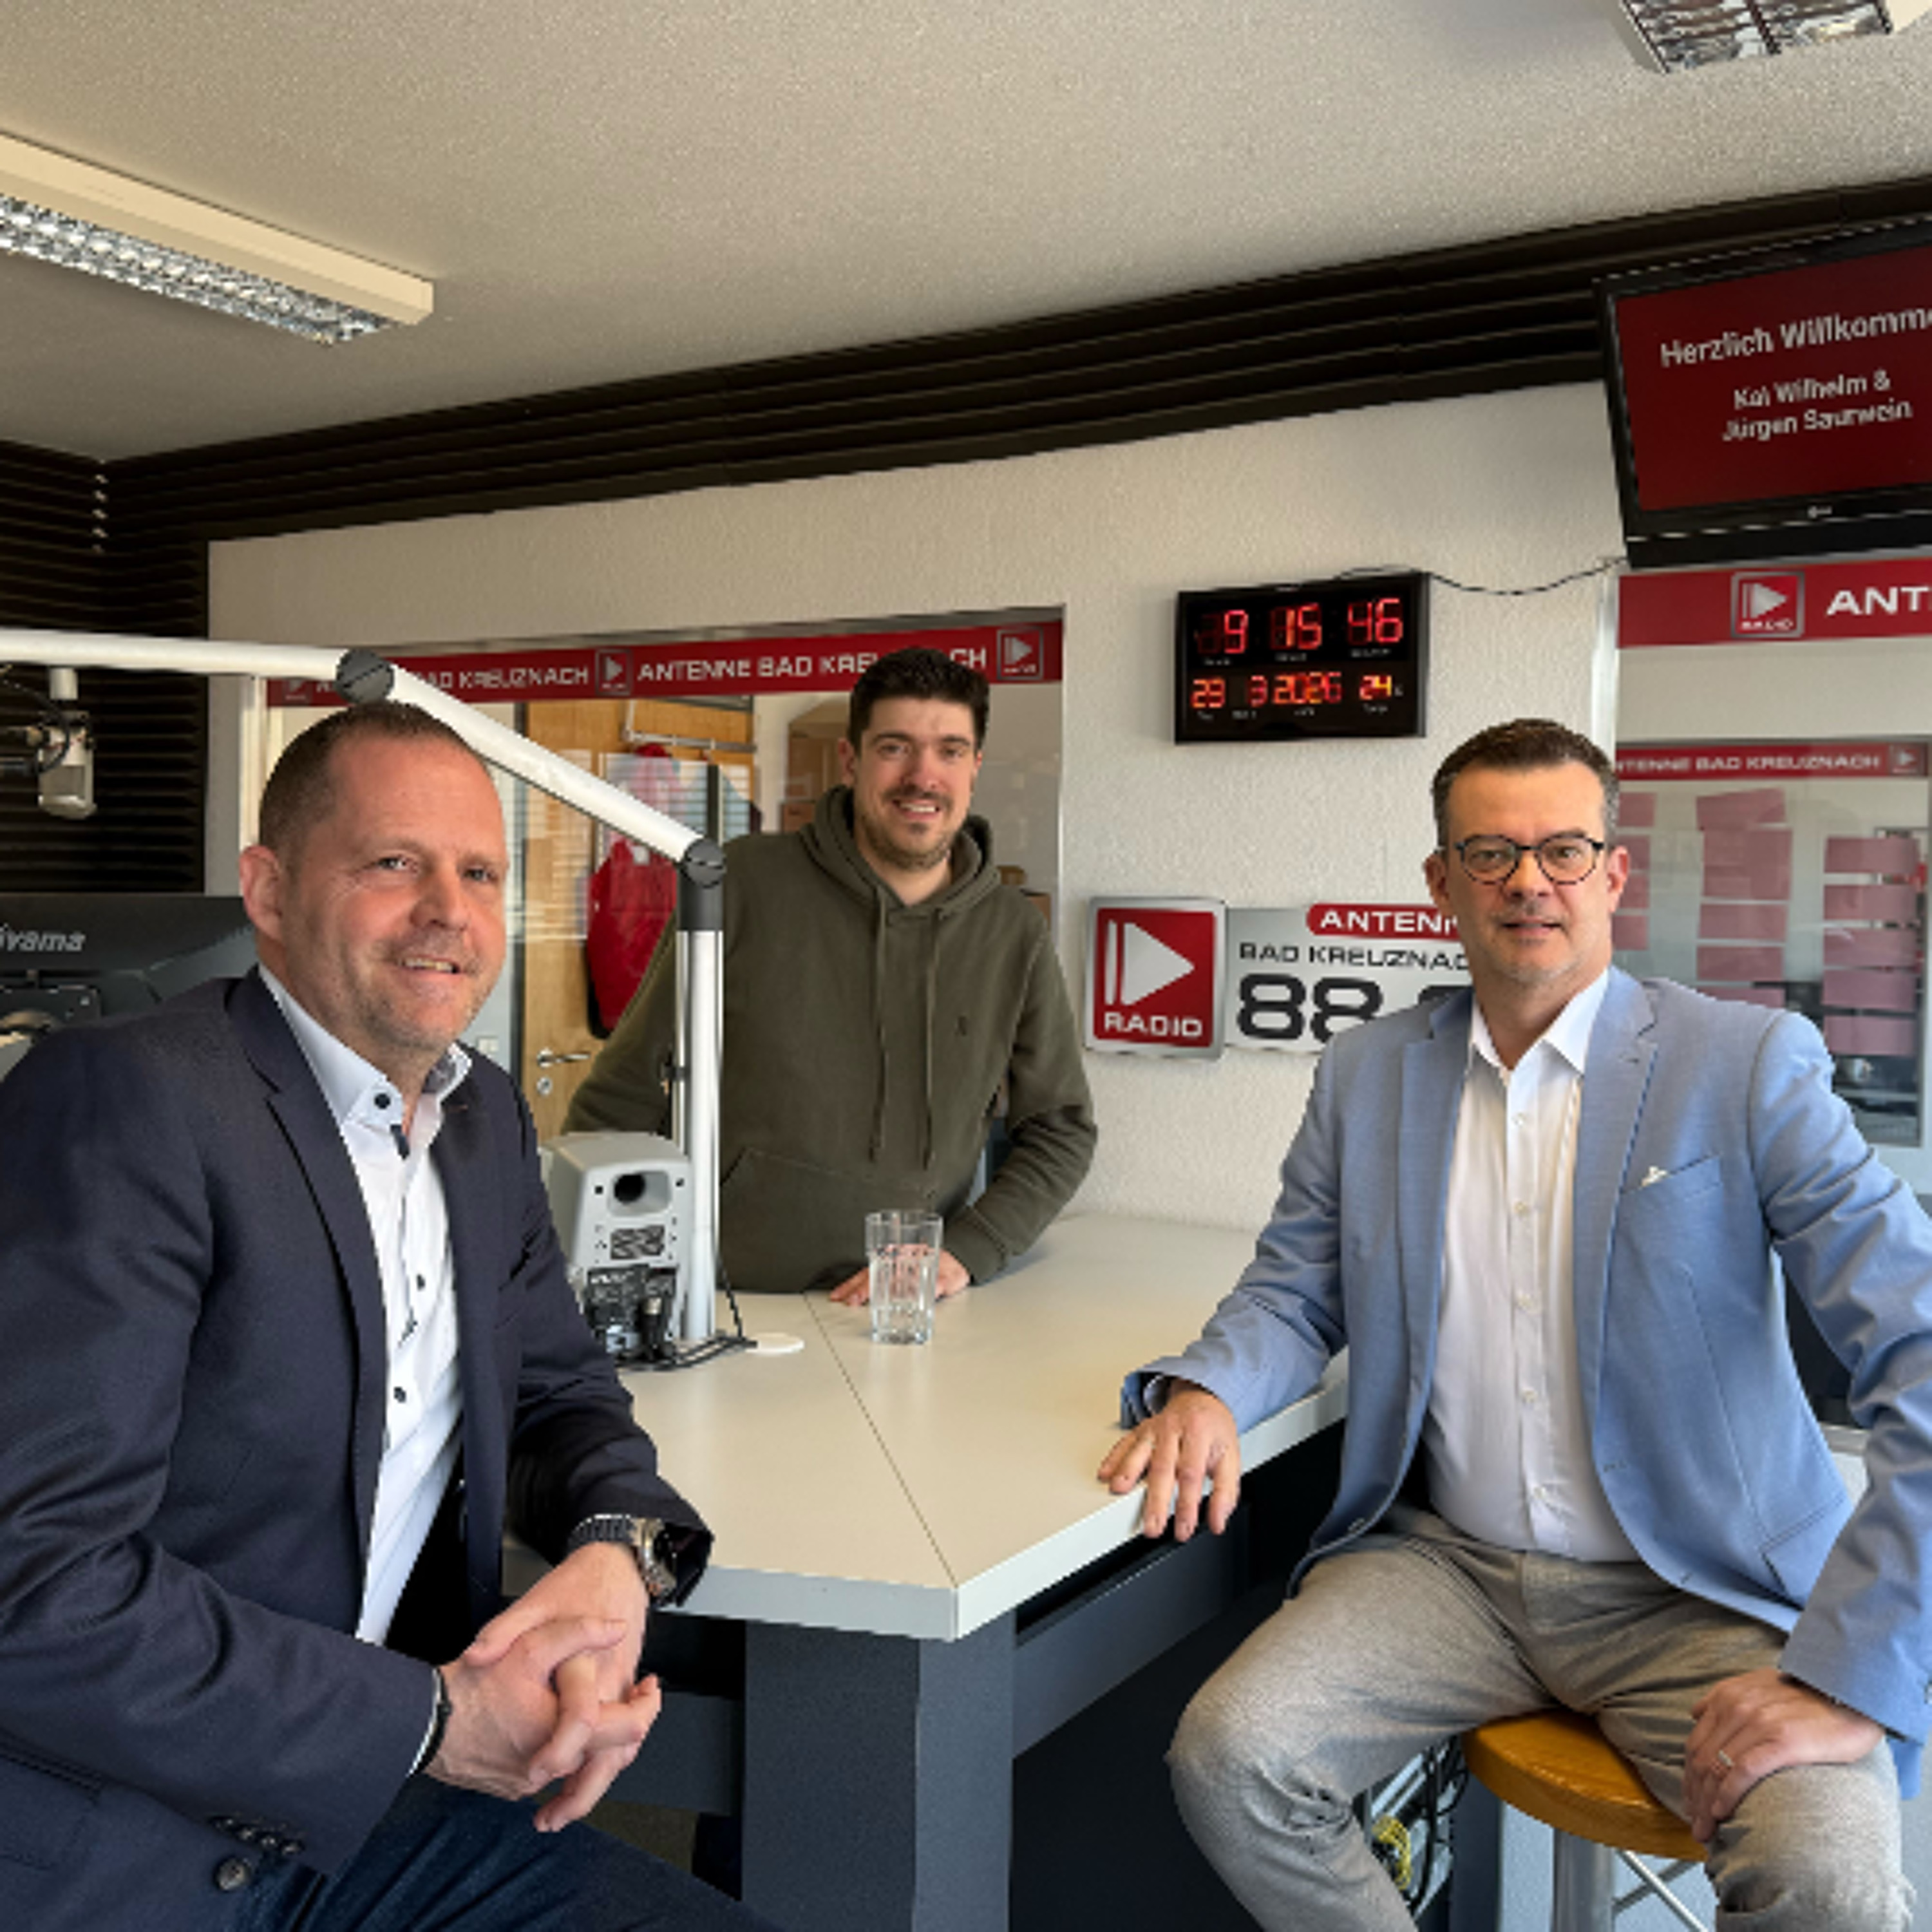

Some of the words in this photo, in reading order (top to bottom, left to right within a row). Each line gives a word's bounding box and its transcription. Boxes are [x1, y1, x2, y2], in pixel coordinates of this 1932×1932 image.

[1660, 327, 1774, 367] Herzlich
[1774, 374, 1867, 404] Wilhelm
[1873, 370, 1891, 391] &
[1826, 586, 1932, 616] ANT
[1224, 610, 1248, 654] 9
[1284, 602, 1322, 649] 15
[1348, 598, 1403, 643] 46
[459, 665, 589, 690] KREUZNACH
[638, 658, 751, 681] ANTENNE
[757, 652, 813, 677] BAD
[1695, 757, 1740, 770] BAD
[1745, 755, 1880, 770] KREUZNACH
[1240, 943, 1300, 961] BAD
[1104, 1012, 1203, 1038] RADIO
